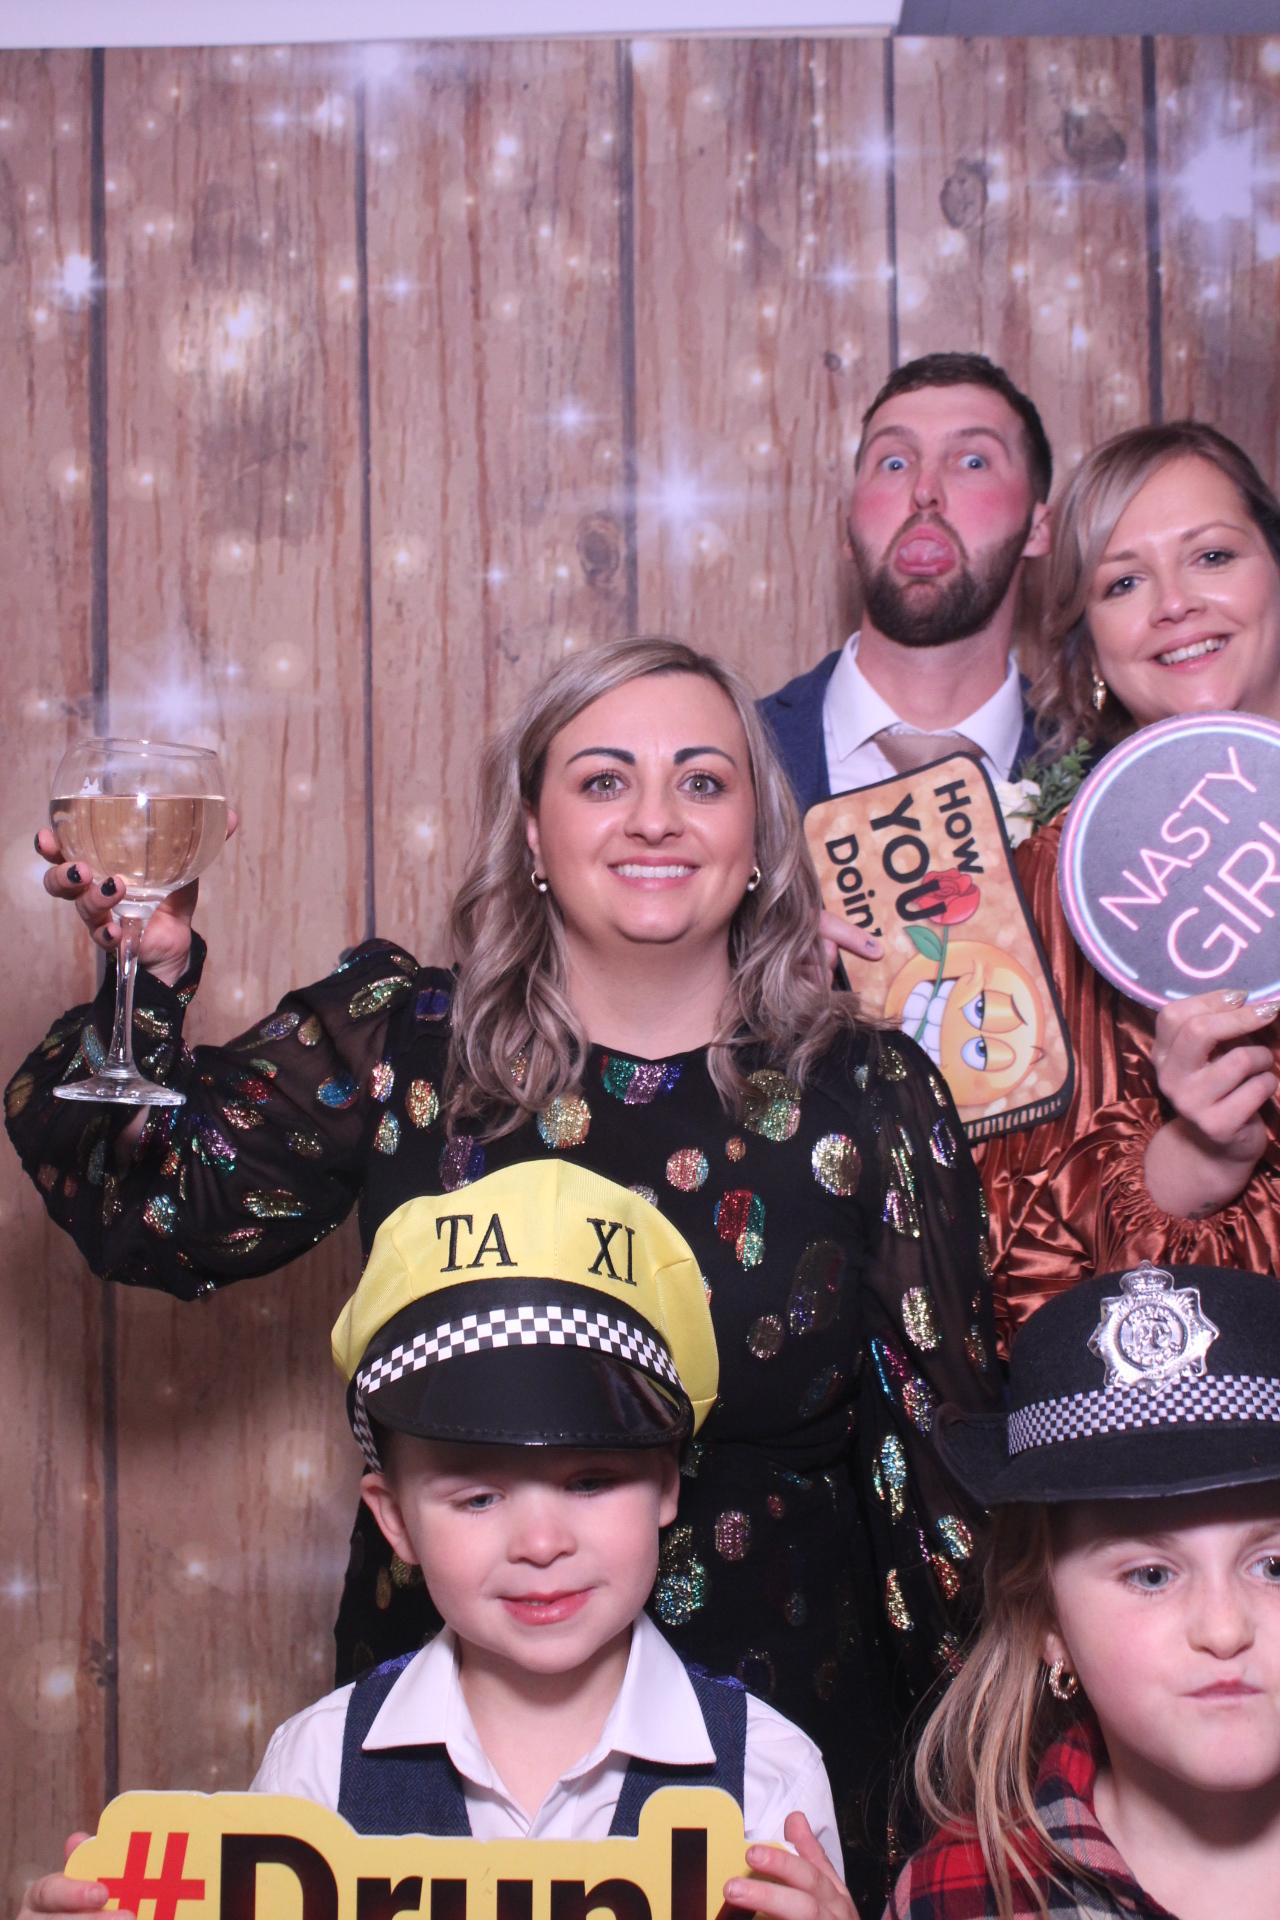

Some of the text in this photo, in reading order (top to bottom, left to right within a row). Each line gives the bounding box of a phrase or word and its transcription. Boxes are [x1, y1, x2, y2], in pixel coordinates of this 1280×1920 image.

[870, 793, 948, 922] YOU
[933, 779, 985, 875] How
[1099, 746, 1257, 931] NASTY
